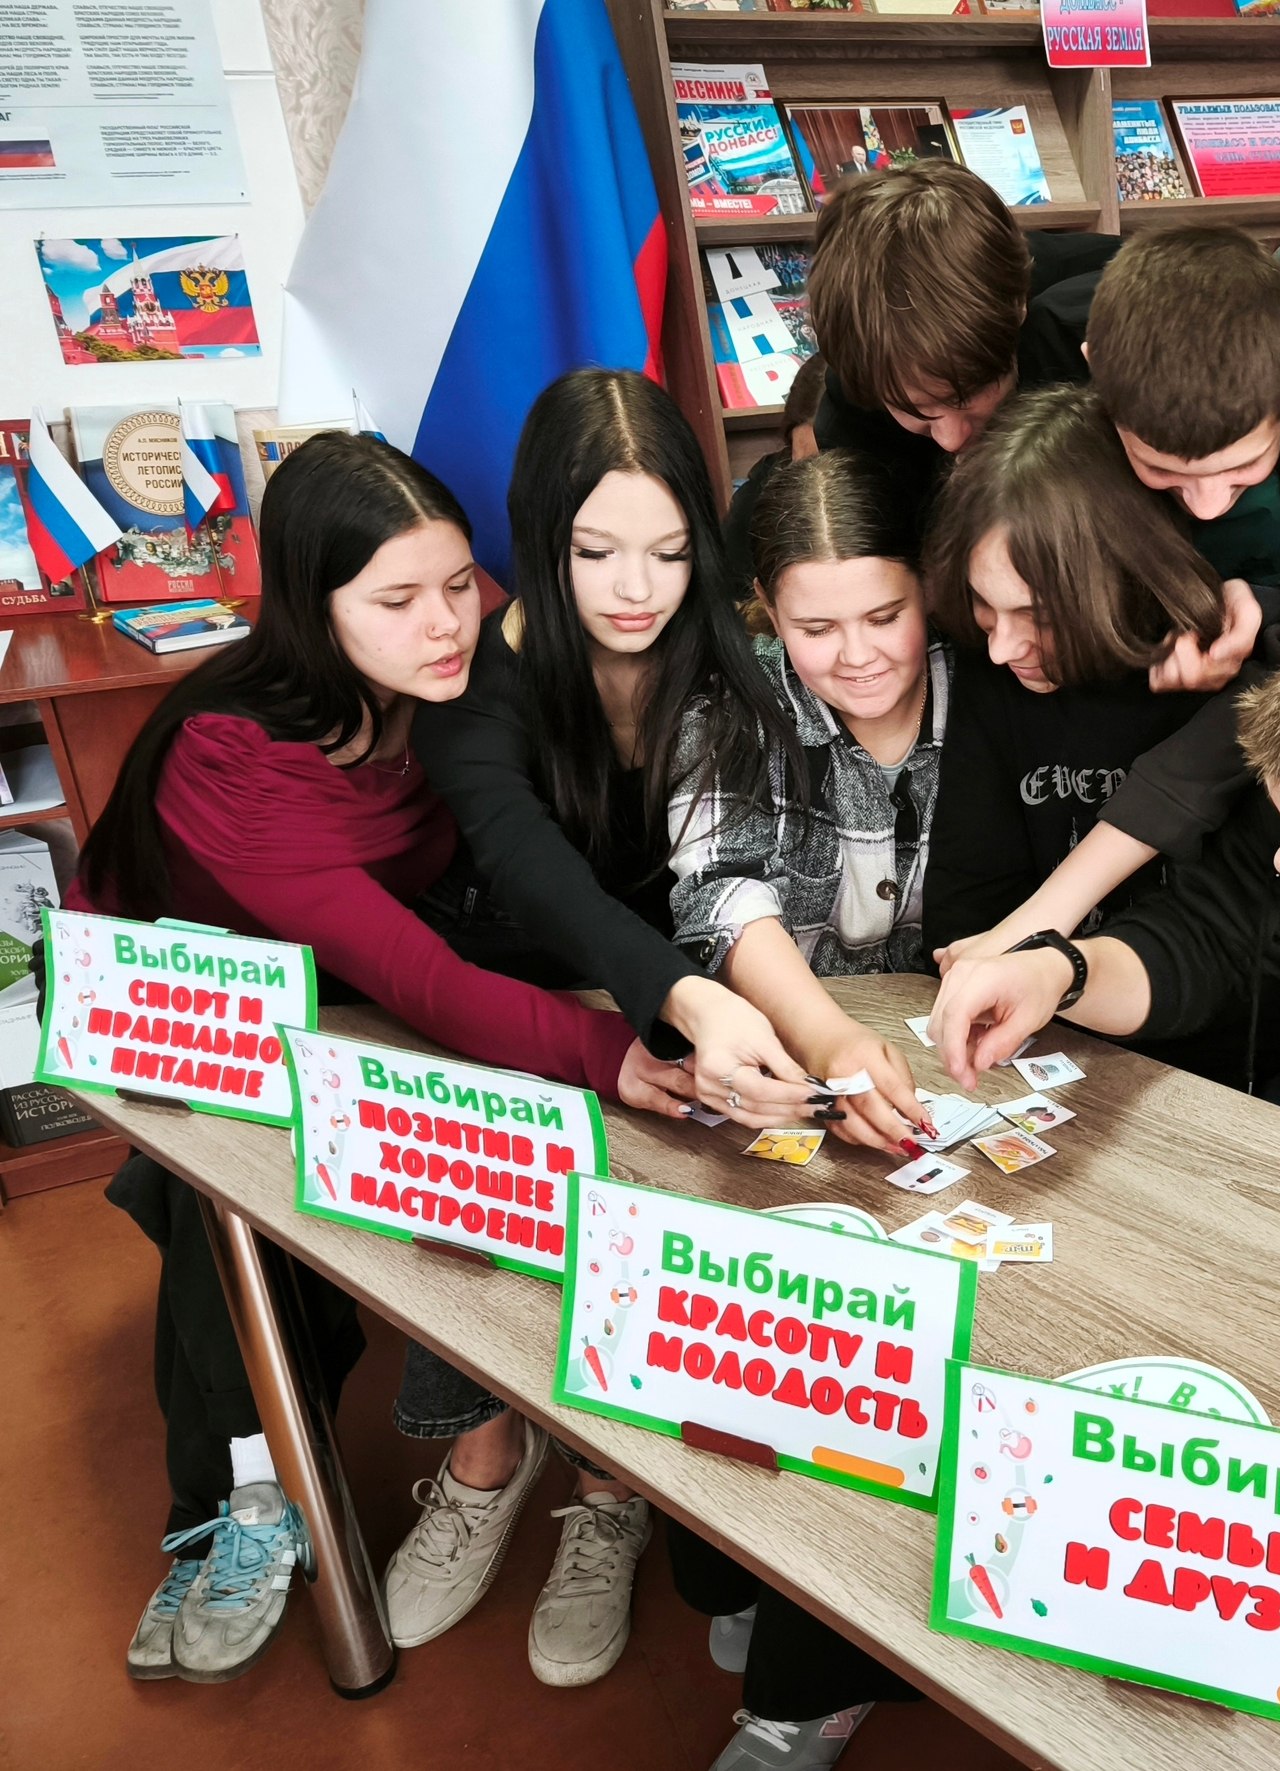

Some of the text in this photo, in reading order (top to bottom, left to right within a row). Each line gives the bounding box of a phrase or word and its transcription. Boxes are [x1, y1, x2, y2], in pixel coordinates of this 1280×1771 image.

[1047, 26, 1144, 52] РУССКАЯ ЗЕМЛЯ
[674, 79, 747, 100] ВЕСНИКИ
[708, 128, 778, 156] ДОНБАСС!
[122, 452, 181, 462] ИСТОРИЧЕС
[138, 466, 182, 476] ЛЕТОПИС
[2, 594, 48, 606] СУДЬБА
[114, 933, 286, 988] Выбирай
[128, 979, 263, 1025] СПОРТ И
[88, 1008, 287, 1066] ПРАВИЛЬНО
[110, 1047, 264, 1098] ПИТАНИЕ
[358, 1056, 564, 1131] Выбирай
[358, 1099, 575, 1175] ПОЗИТИВ И
[379, 1142, 554, 1212] ХОРОШЕЕ
[350, 1172, 565, 1256] НАСТРОЕНИ
[661, 1230, 916, 1331] Выбирай
[658, 1286, 914, 1384] КРАСОТУ И
[646, 1332, 928, 1439] МОЛОДОСТЬ
[1064, 1540, 1110, 1591] И
